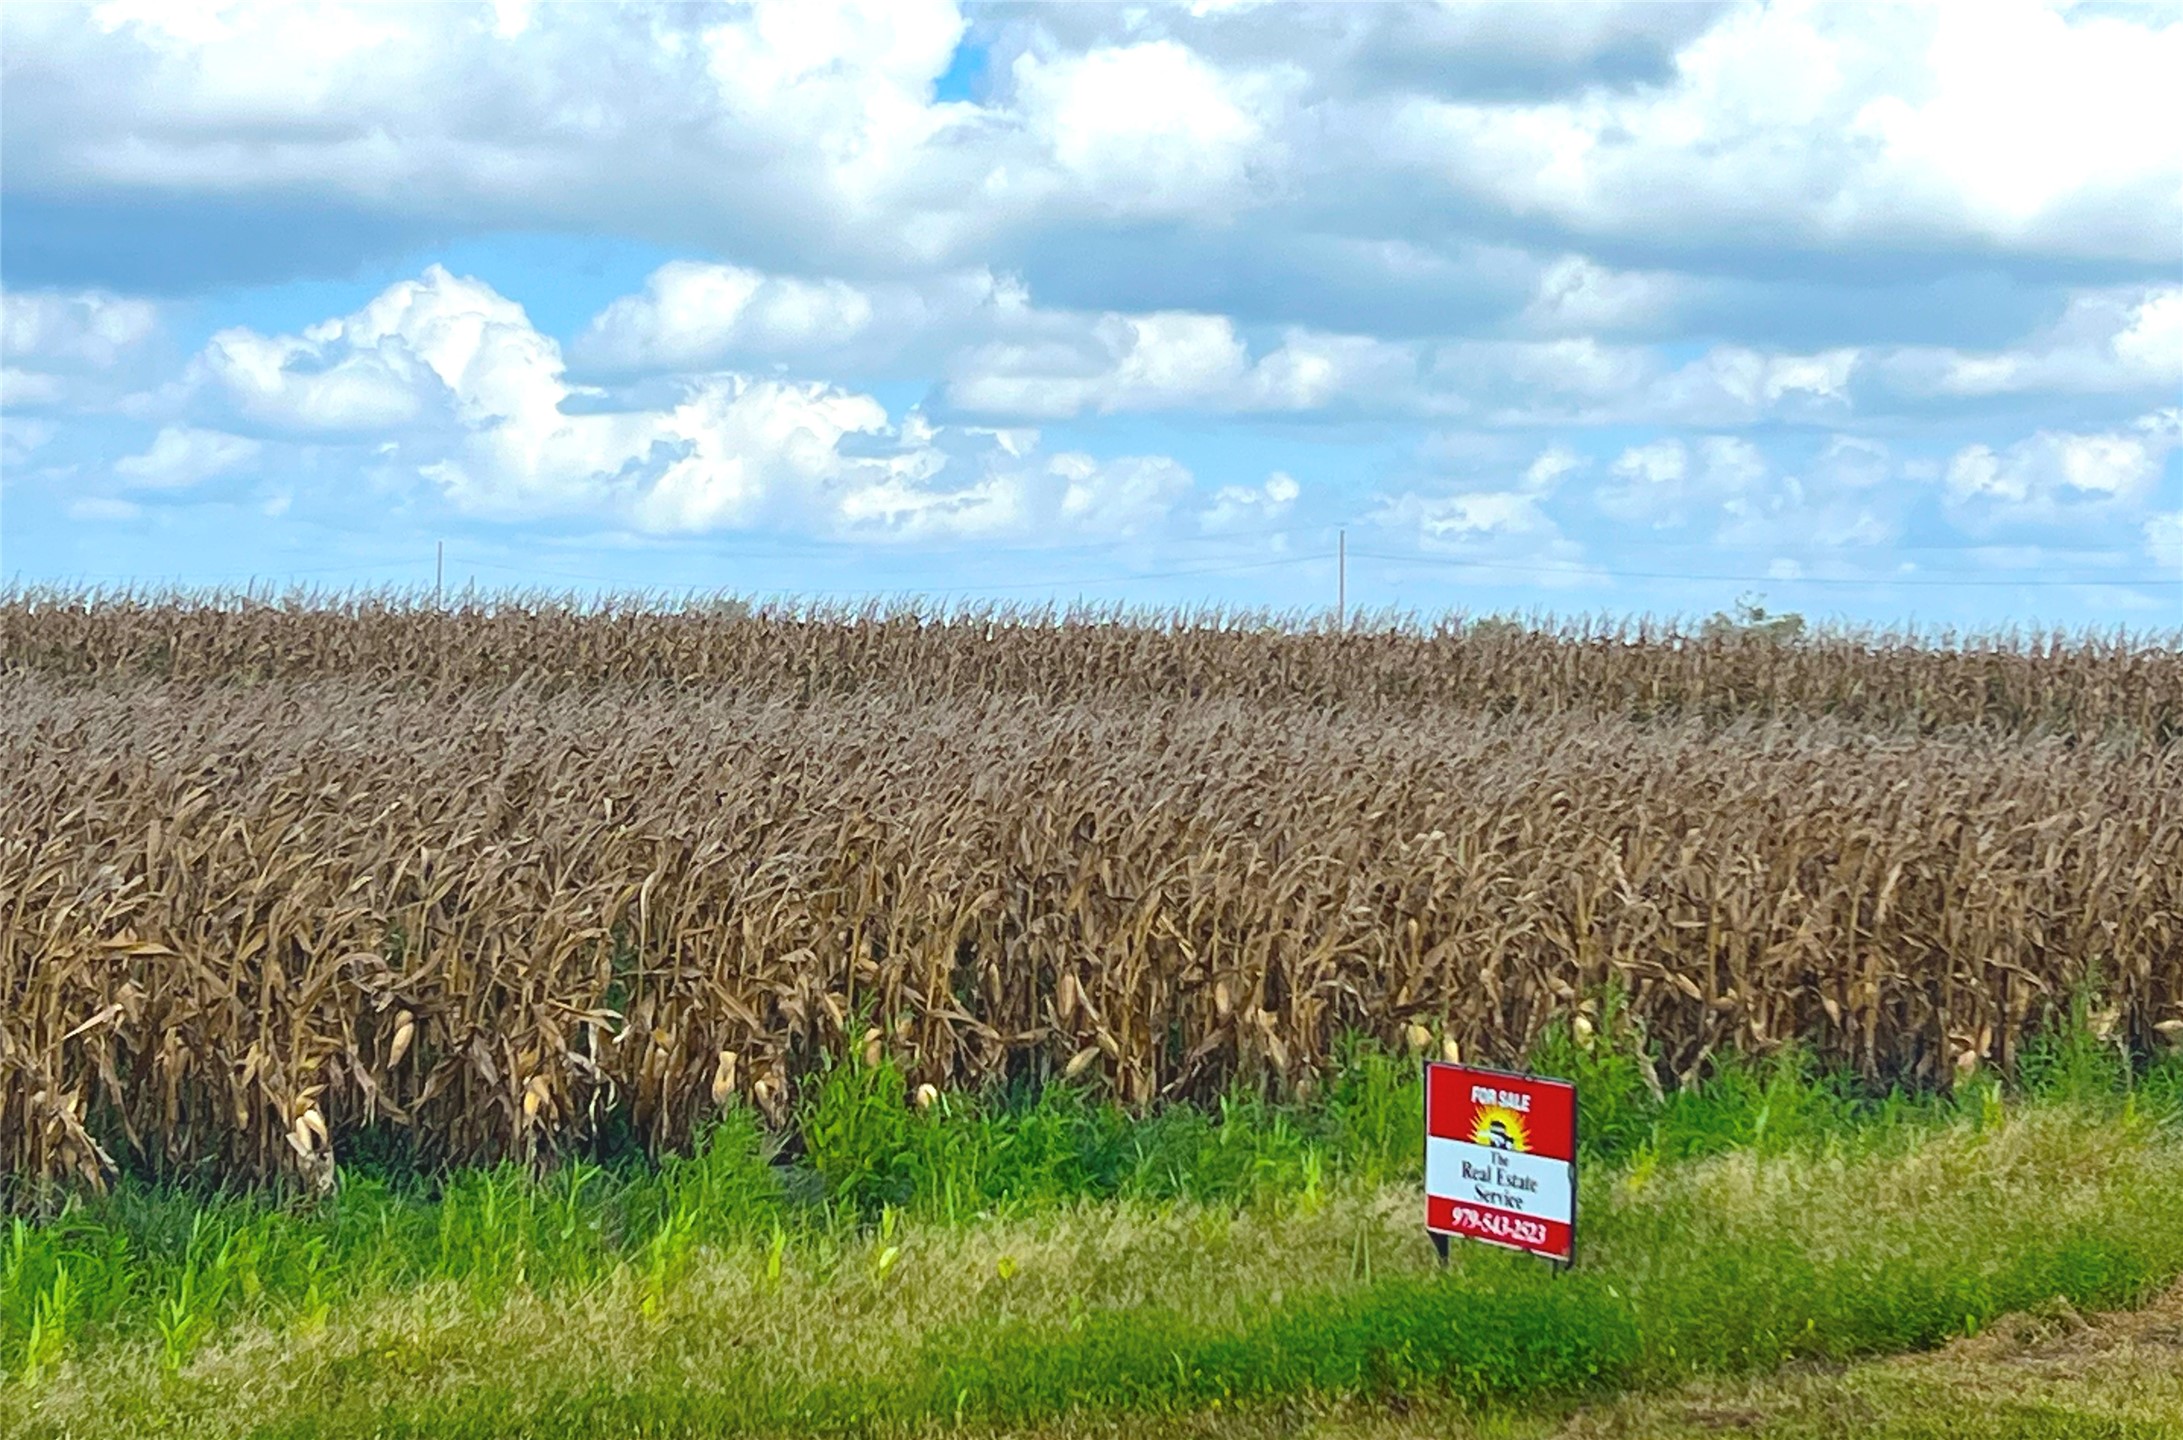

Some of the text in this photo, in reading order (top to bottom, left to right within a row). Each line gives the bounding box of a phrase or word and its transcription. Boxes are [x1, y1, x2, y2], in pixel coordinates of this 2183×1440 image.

[1471, 1085, 1531, 1112] FOR SALE
[1490, 1151, 1508, 1167] The
[1461, 1160, 1538, 1193] Real Estate
[1475, 1184, 1523, 1210] Service
